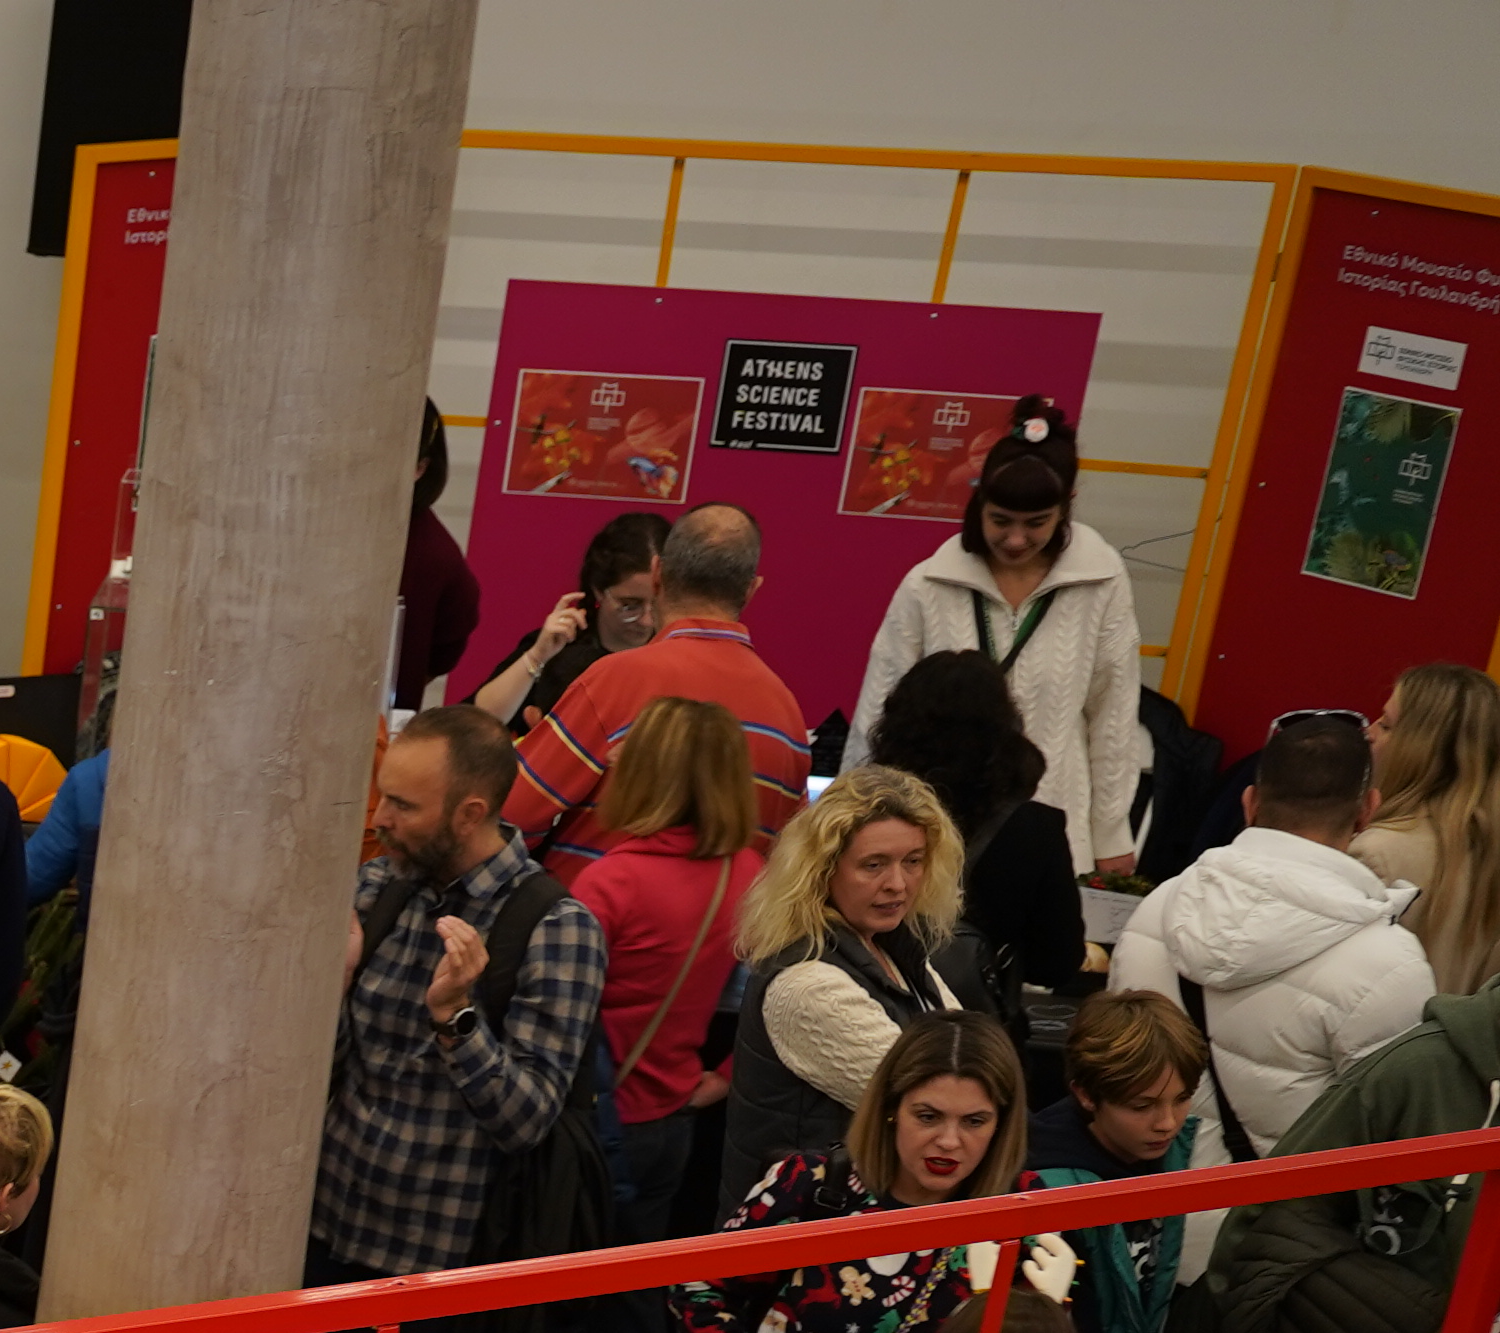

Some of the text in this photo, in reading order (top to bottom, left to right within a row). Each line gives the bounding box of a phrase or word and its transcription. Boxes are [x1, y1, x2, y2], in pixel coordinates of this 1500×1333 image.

[1342, 244, 1400, 269] Εθνικό
[1400, 254, 1474, 282] Μουσείο
[1337, 267, 1409, 298] Ιστορίας
[740, 357, 825, 382] ATHENS
[735, 383, 821, 408] SCIENCE
[730, 409, 826, 434] FESTIVAL
